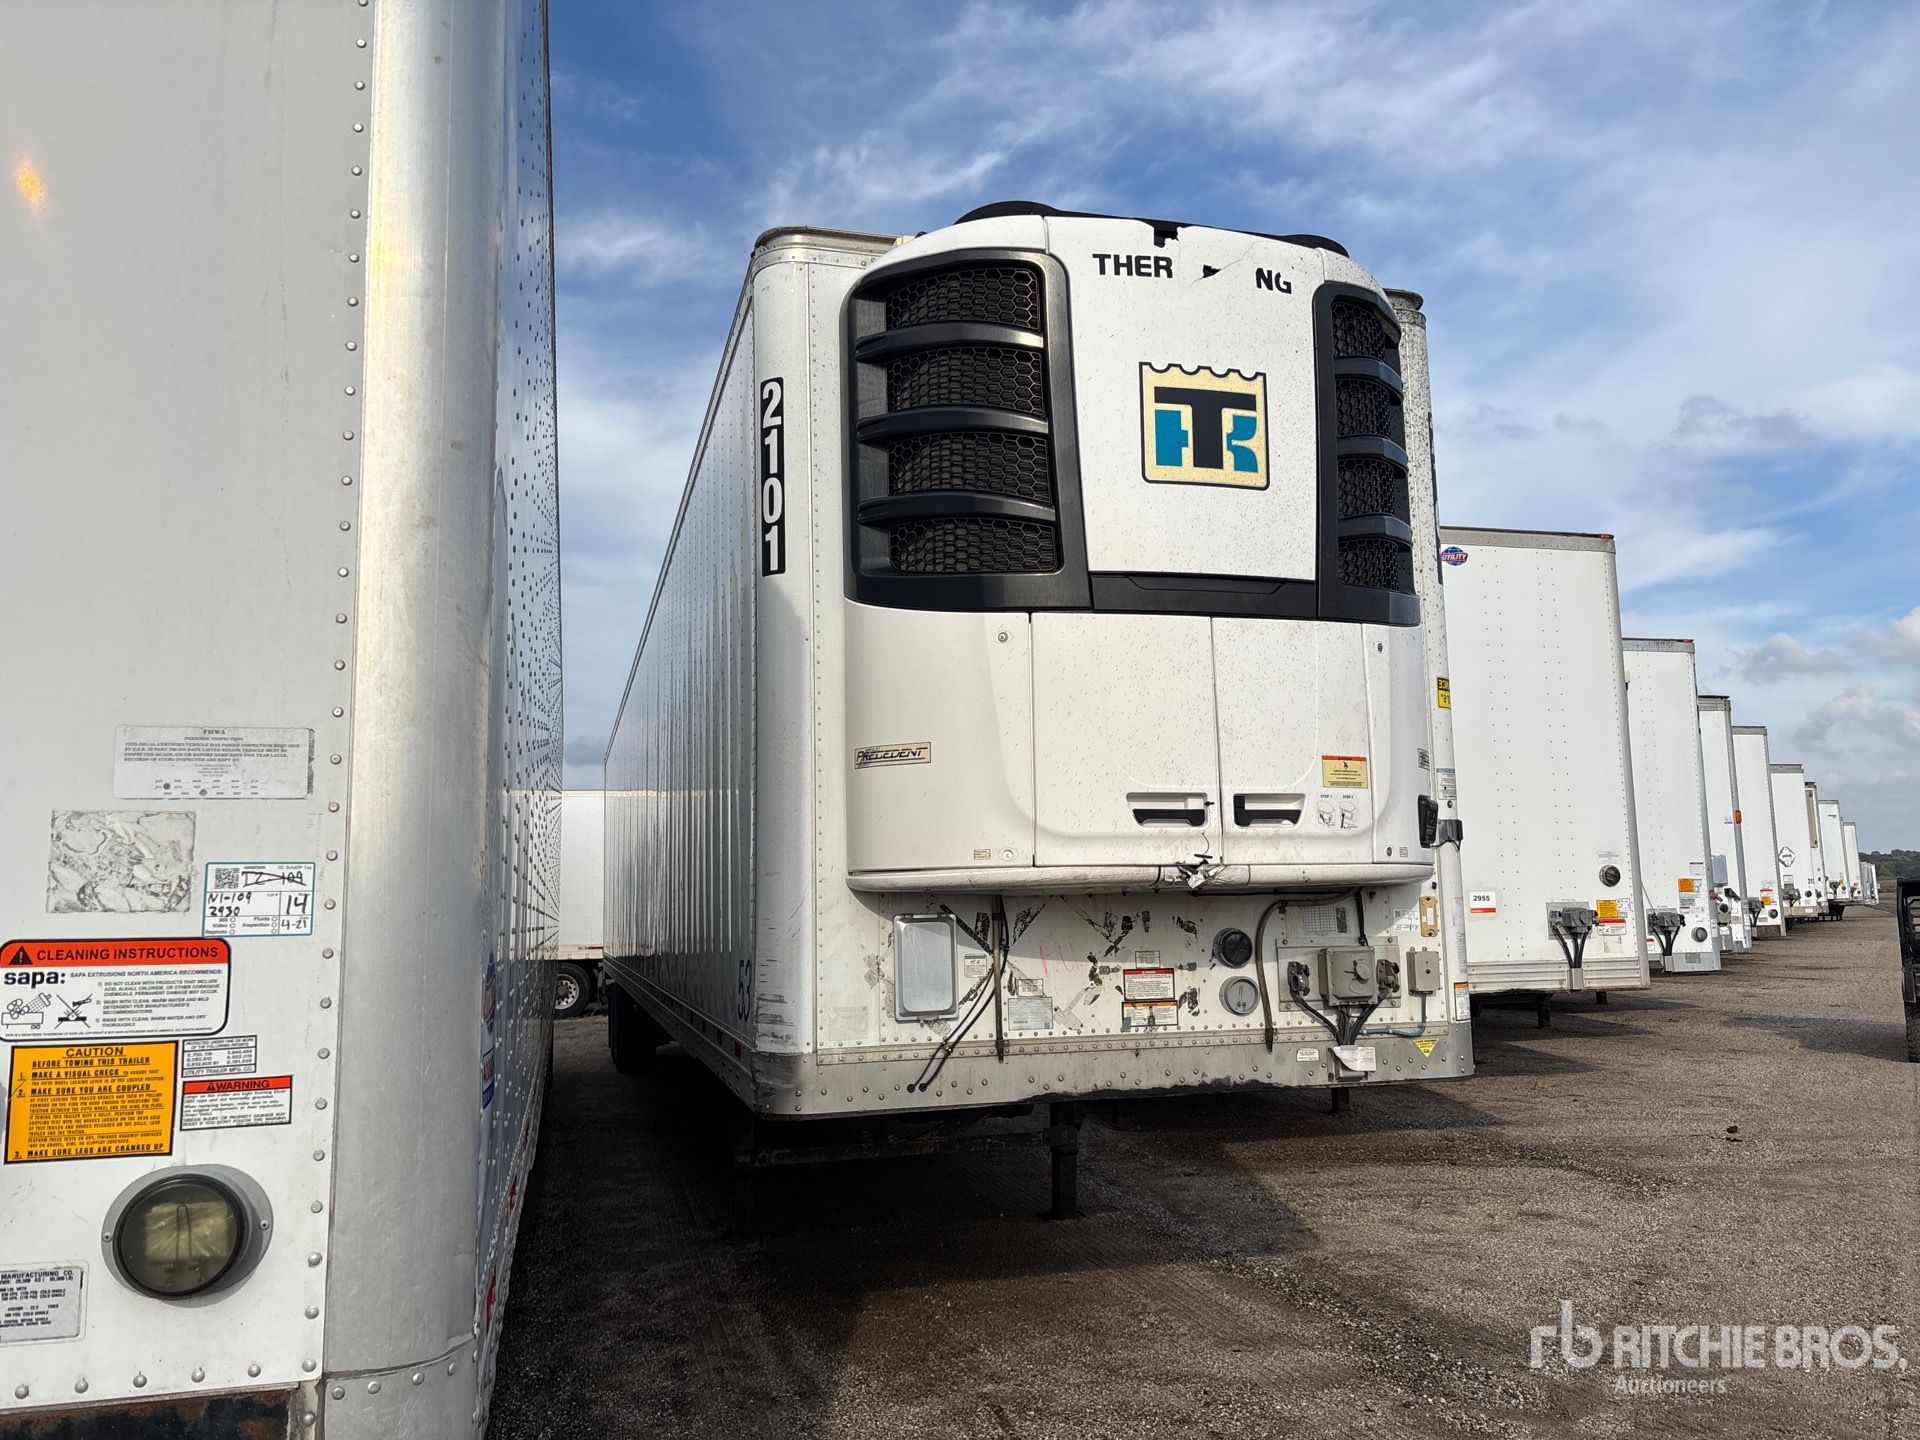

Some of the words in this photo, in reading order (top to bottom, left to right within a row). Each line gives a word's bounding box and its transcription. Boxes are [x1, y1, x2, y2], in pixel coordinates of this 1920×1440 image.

[763, 381, 783, 572] 2101
[1442, 553, 1467, 561] UTILITY
[286, 894, 308, 915] 14
[37, 949, 110, 962] CLEANING
[114, 946, 218, 960] INSTRUCTIONS
[738, 959, 752, 1022] 53
[65, 1046, 124, 1057] CAUTION
[31, 1059, 61, 1068] BEFORE
[64, 1058, 94, 1066] TOWING
[97, 1057, 115, 1065] THIS
[118, 1056, 150, 1064] TRAILER
[31, 1071, 53, 1079] MAKE
[55, 1070, 61, 1078] A
[64, 1069, 91, 1077] VISUAL
[94, 1068, 119, 1076] CHECK
[17, 1088, 25, 1096] 2.
[30, 1087, 52, 1095] MAKE
[55, 1086, 75, 1094] SURE
[79, 1085, 94, 1093] YOU
[116, 1083, 150, 1092] COUPLED
[215, 1079, 269, 1090] WARNING
[14, 1149, 22, 1157] 3.
[27, 1148, 48, 1156] MAKE
[52, 1147, 72, 1155] SURE
[75, 1146, 93, 1154] LEGS
[97, 1145, 112, 1153] ARE
[115, 1143, 150, 1152] CRANKED
[0, 1270, 59, 1280] MANUFACTURING
